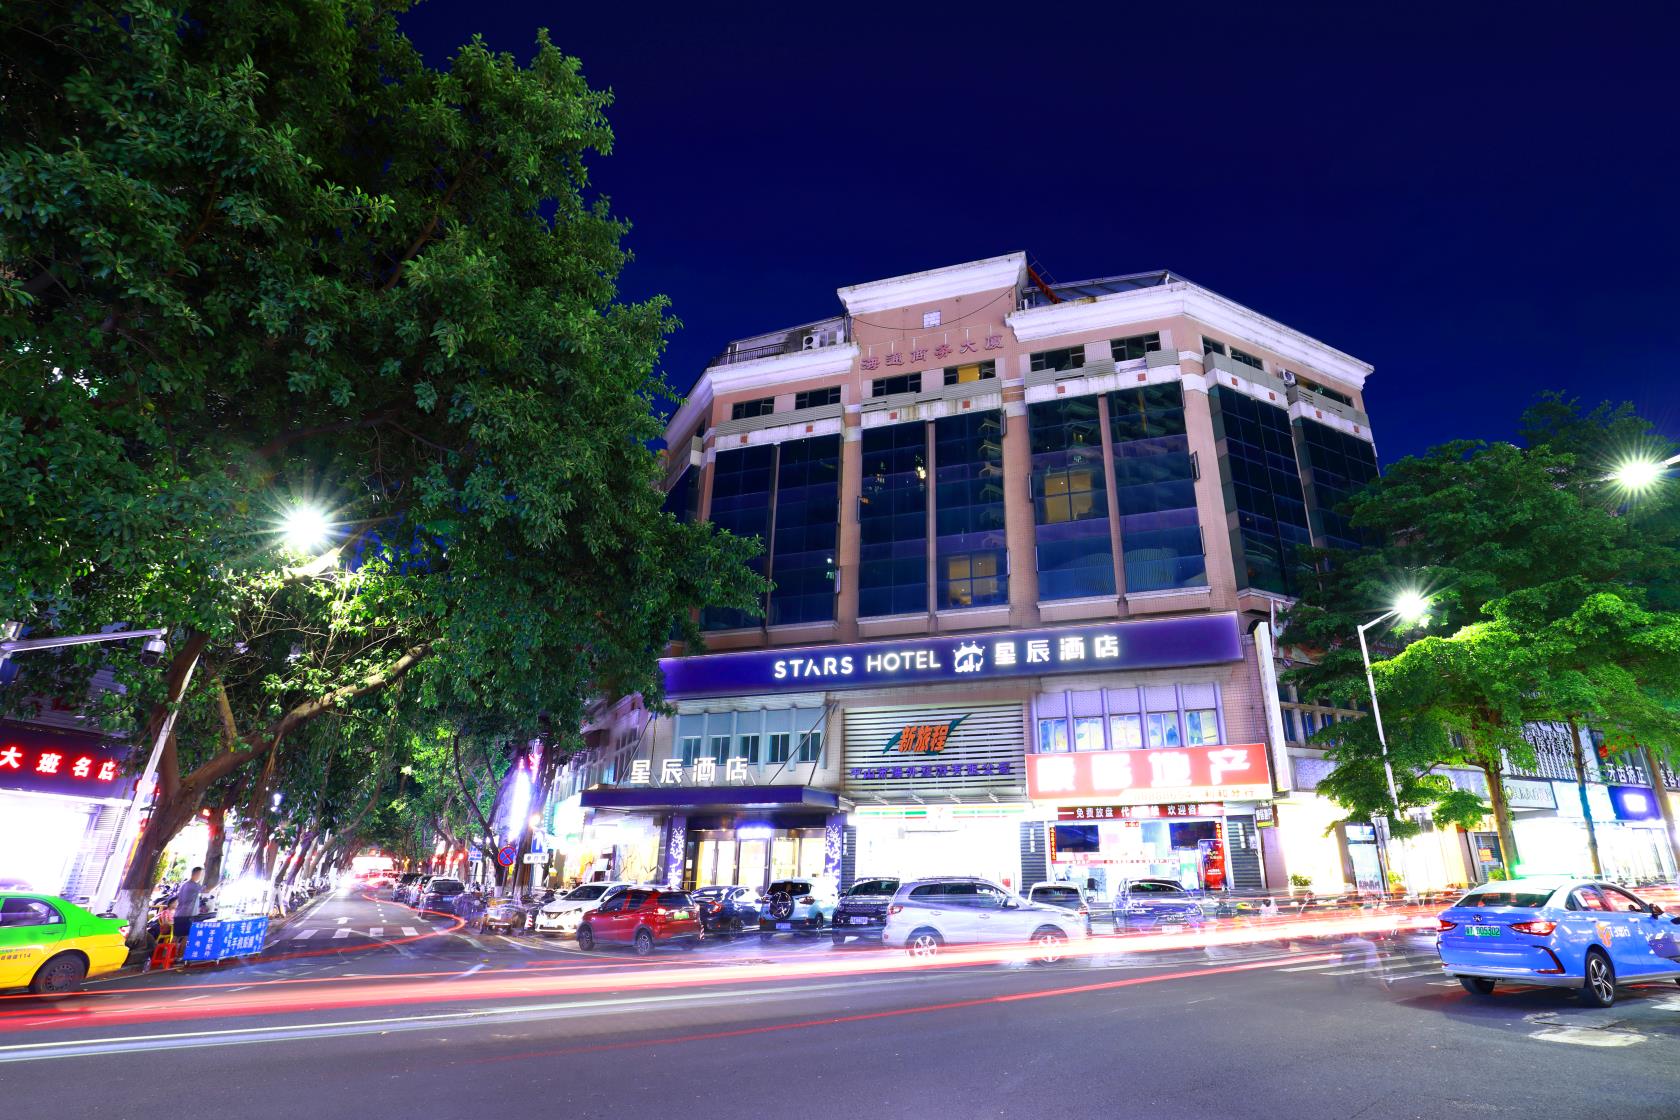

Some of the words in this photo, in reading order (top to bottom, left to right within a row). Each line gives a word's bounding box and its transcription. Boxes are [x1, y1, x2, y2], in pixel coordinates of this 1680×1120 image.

[994, 635, 1119, 665] 星辰酒店
[774, 656, 853, 679] STARS
[867, 650, 941, 672] HOTEL
[898, 725, 949, 752] 新旅程
[630, 756, 748, 784] 星辰酒店
